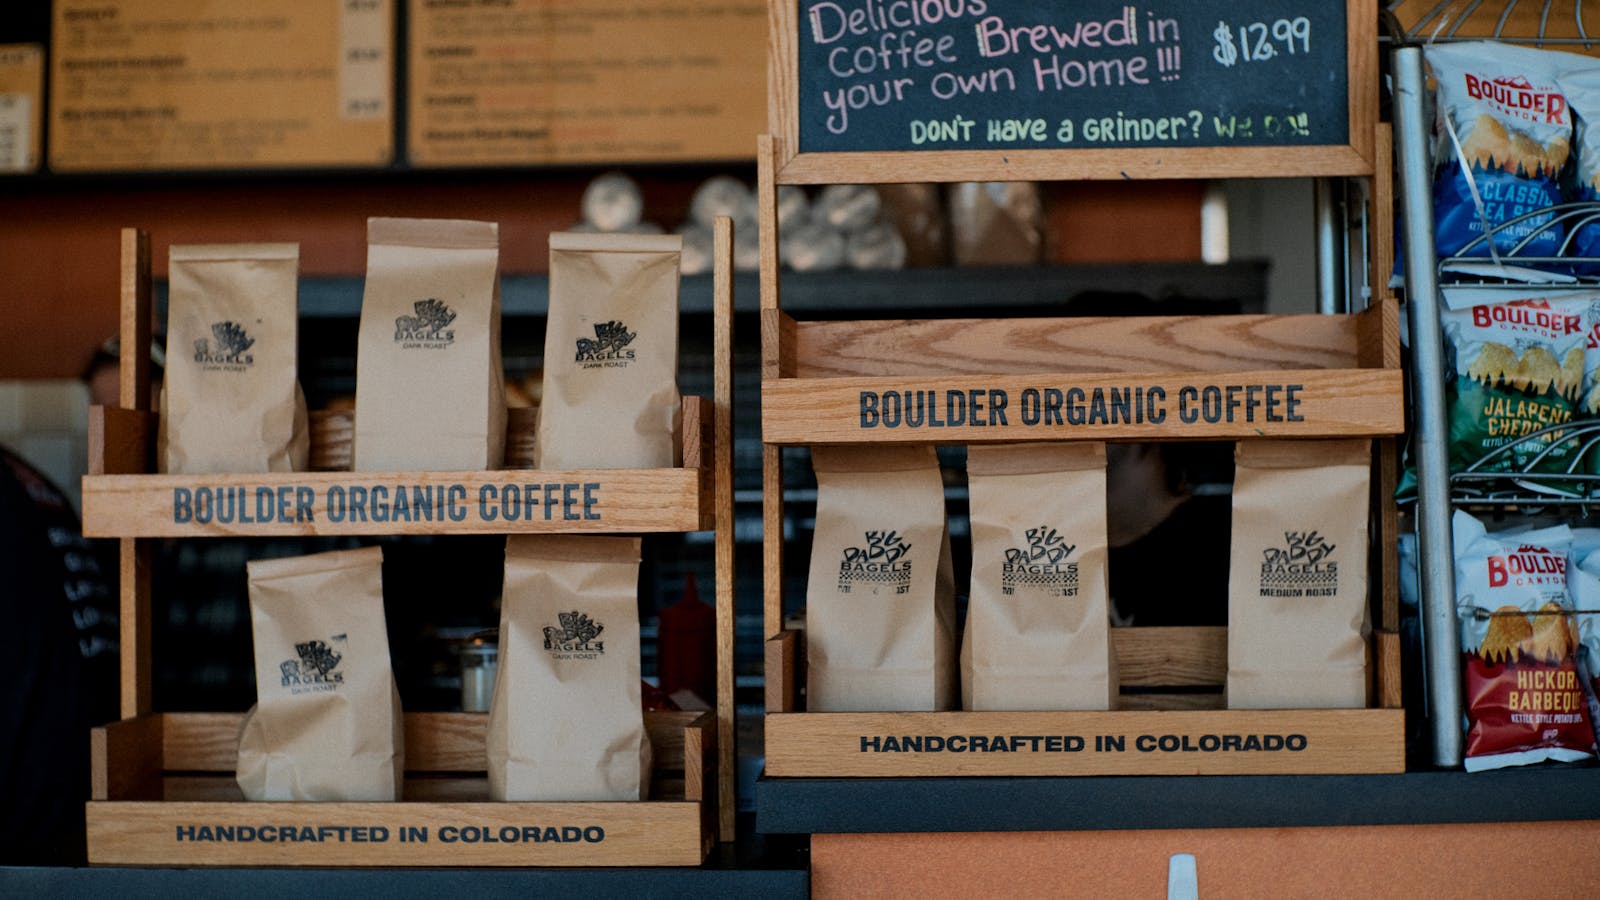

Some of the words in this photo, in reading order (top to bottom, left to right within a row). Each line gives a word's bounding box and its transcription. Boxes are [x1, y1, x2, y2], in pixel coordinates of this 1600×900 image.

[828, 30, 957, 78] coffee
[975, 6, 1138, 57] Brewed
[1147, 11, 1180, 43] in
[1212, 17, 1311, 67] $12.99
[823, 78, 914, 134] your
[1033, 54, 1150, 91] Home
[1465, 73, 1567, 125] BOULDER
[1057, 119, 1074, 143] a
[1472, 305, 1582, 335] BOULDER
[1500, 324, 1557, 339] CANYON
[575, 350, 636, 362] BAGELS
[860, 389, 1009, 429] BOULDER
[1020, 386, 1166, 427] ORGANIC
[1179, 384, 1305, 424] COFFEE
[174, 486, 315, 524] BOULDER
[326, 484, 467, 523] ORGANIC
[479, 483, 600, 521] COFFEE
[843, 543, 912, 564] DADDY
[1004, 542, 1076, 566] DADDY
[1263, 542, 1336, 566] DADDY
[840, 560, 912, 573] BAGELS
[1002, 562, 1079, 575] BAGELS
[1261, 560, 1337, 574] BAGELS
[1260, 588, 1302, 597] MEDIUM
[1305, 588, 1337, 597] ROAST
[544, 641, 604, 652] BAGELS
[860, 735, 1085, 753] HANDCRAFTED
[1095, 735, 1126, 753] IN
[1135, 734, 1308, 752] COLORADO
[176, 825, 390, 843] HANDCRAFTED
[400, 825, 428, 842] IN
[438, 825, 606, 843] COLORADO
